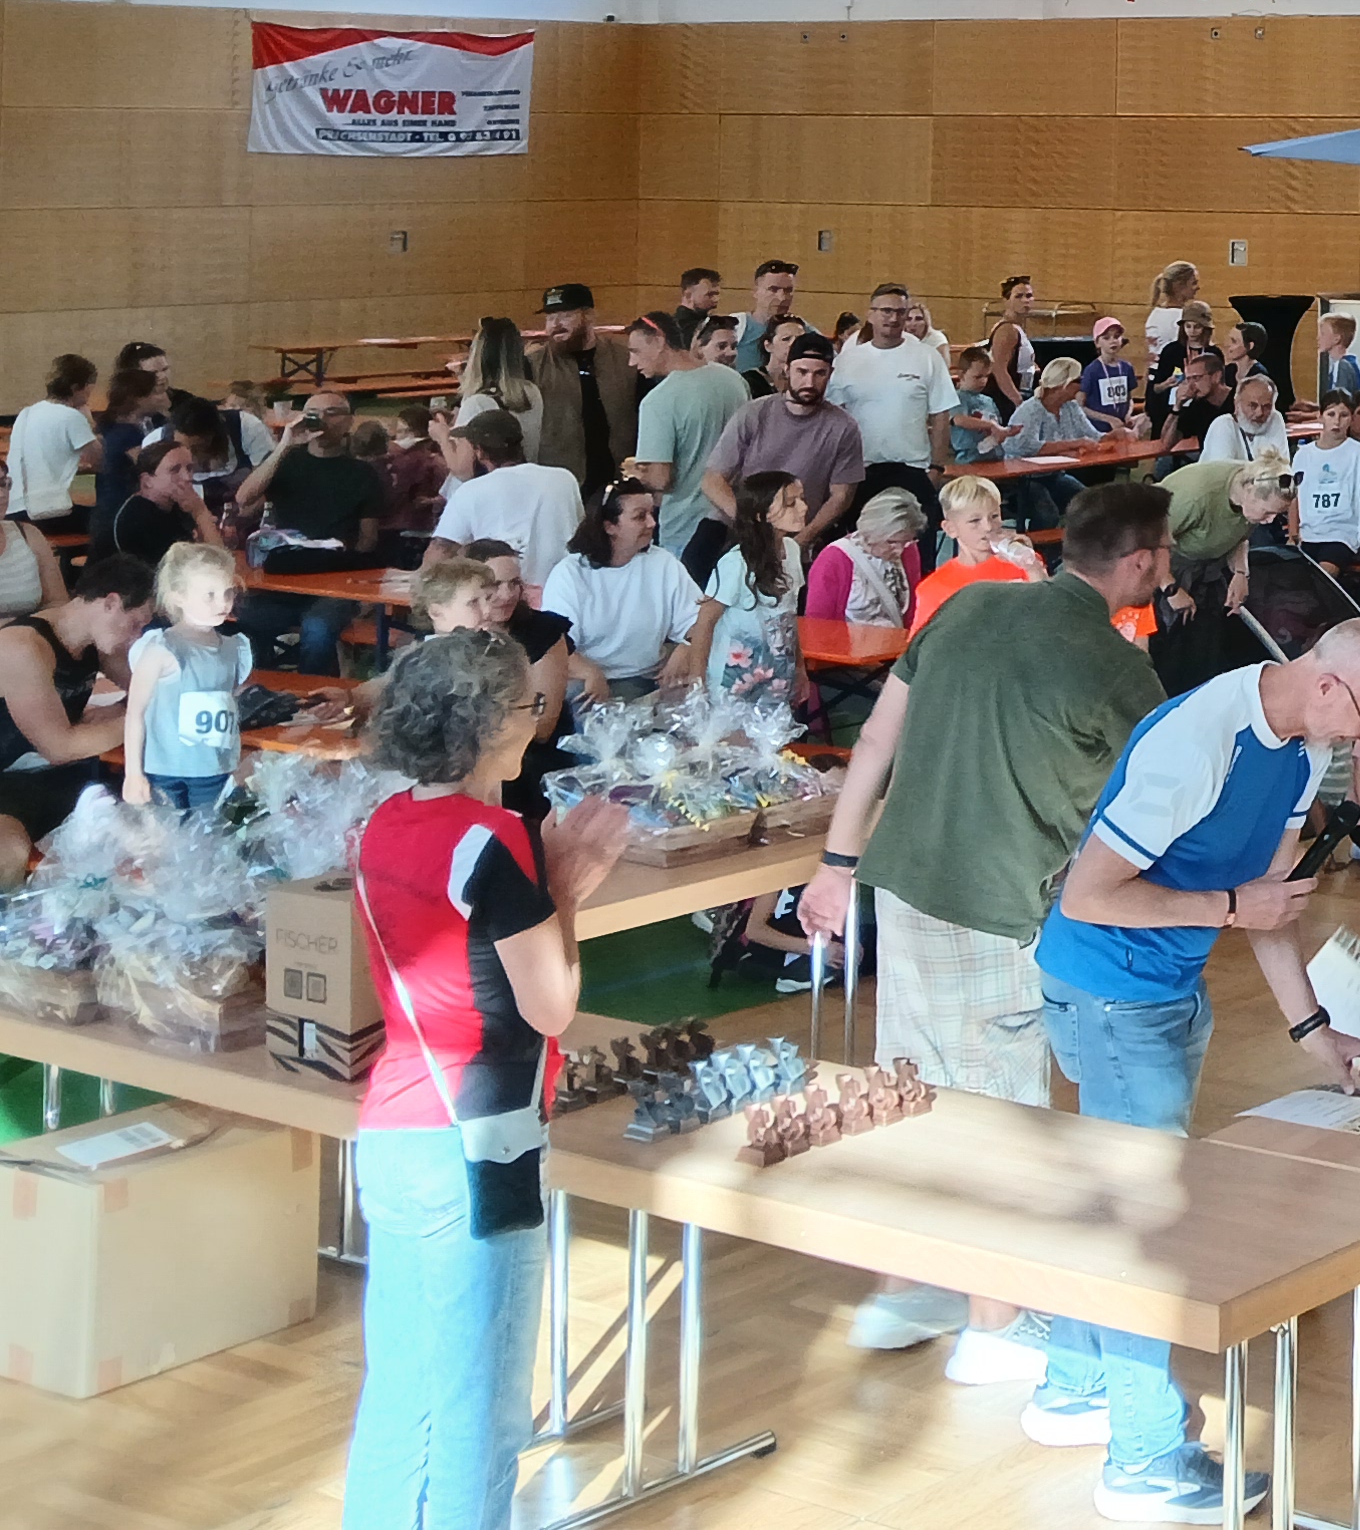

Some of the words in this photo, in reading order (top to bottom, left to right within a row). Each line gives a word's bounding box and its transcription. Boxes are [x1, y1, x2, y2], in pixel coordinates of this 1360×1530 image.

[319, 87, 457, 116] WAGNER
[1312, 493, 1341, 509] 787
[275, 927, 339, 955] FISCHER
